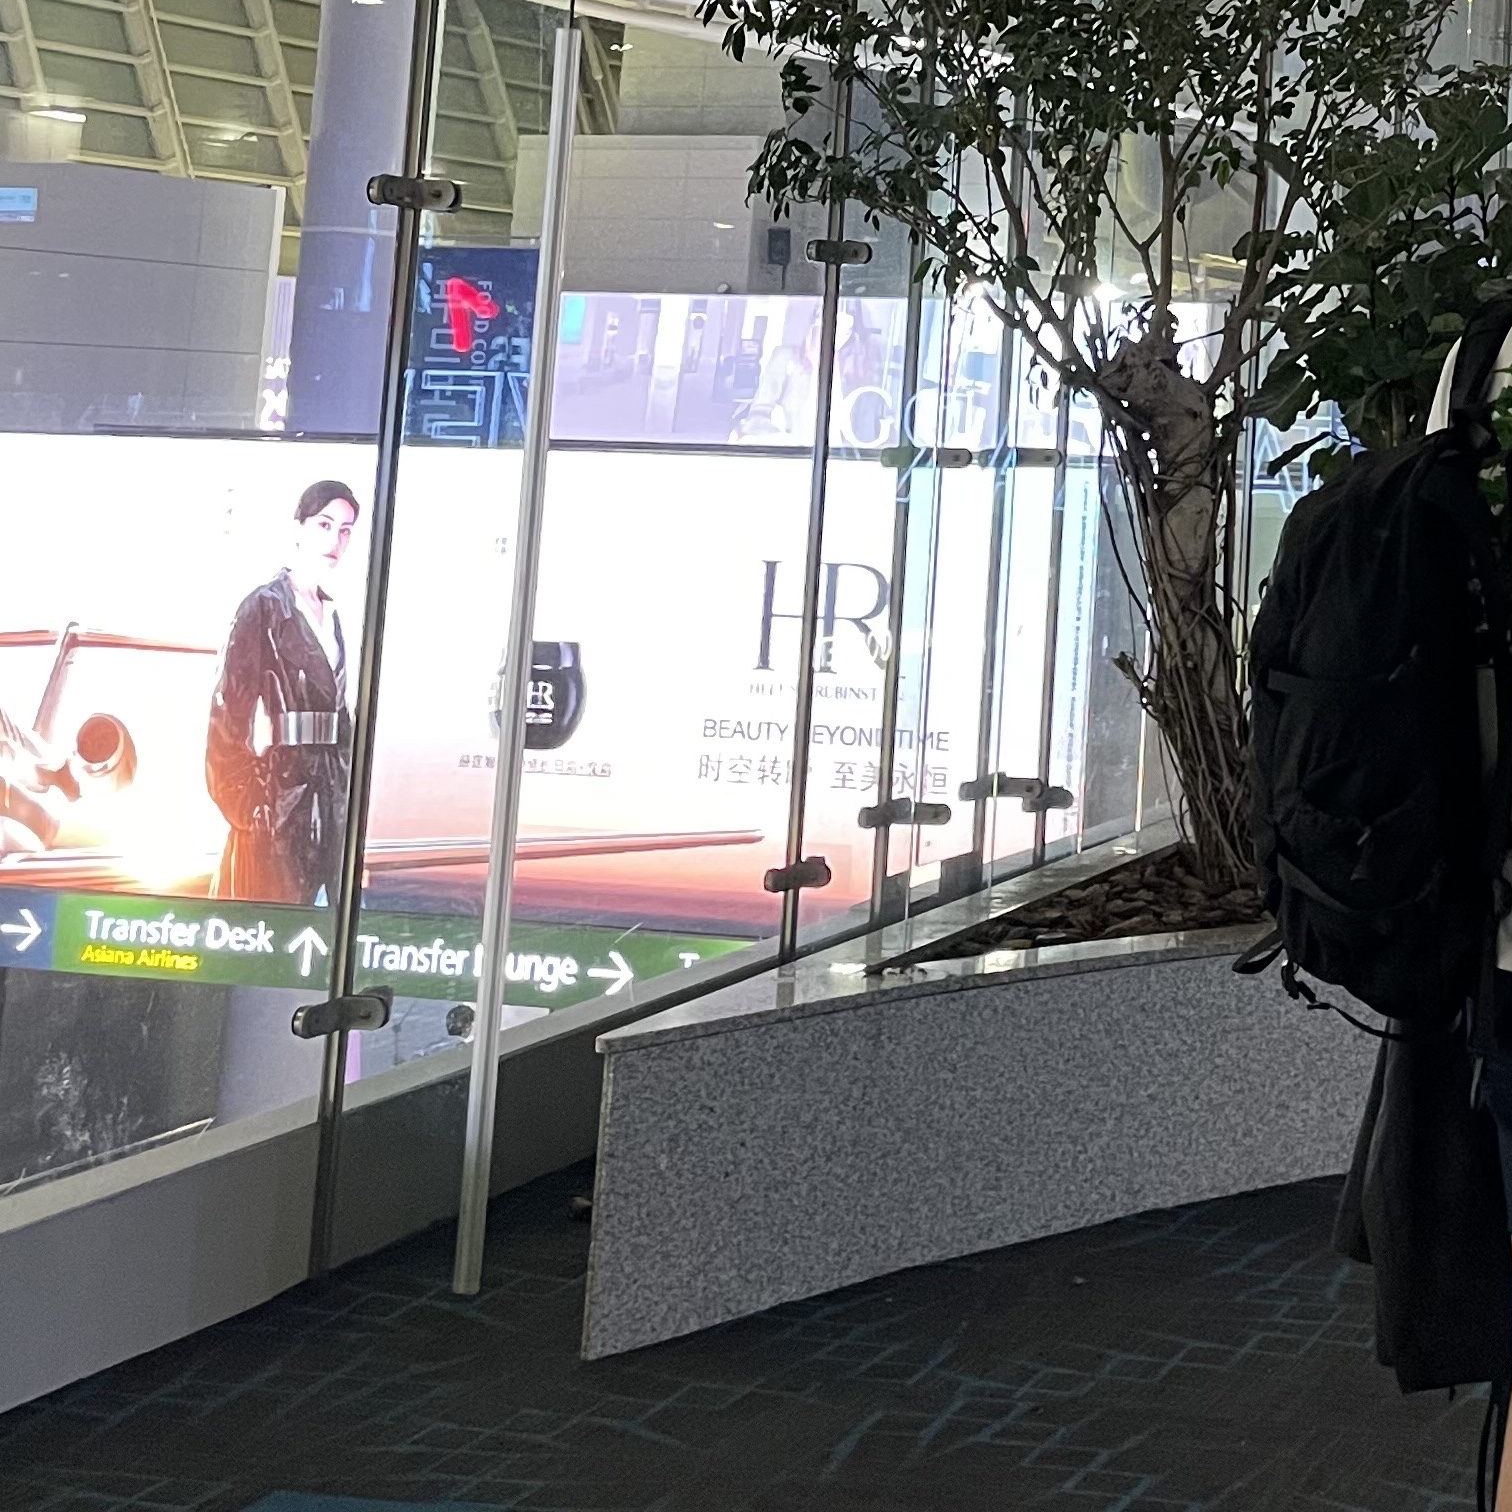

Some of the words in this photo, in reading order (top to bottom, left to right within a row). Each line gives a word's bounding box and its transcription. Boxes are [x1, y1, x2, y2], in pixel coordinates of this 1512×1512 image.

[703, 718, 788, 741] BEAUTY
[85, 909, 201, 947] Transfer
[204, 917, 275, 953] Desk
[81, 944, 135, 965] Asiana
[137, 949, 200, 971] Airlines
[356, 934, 470, 976] Transfer
[472, 943, 579, 993] Lunge
